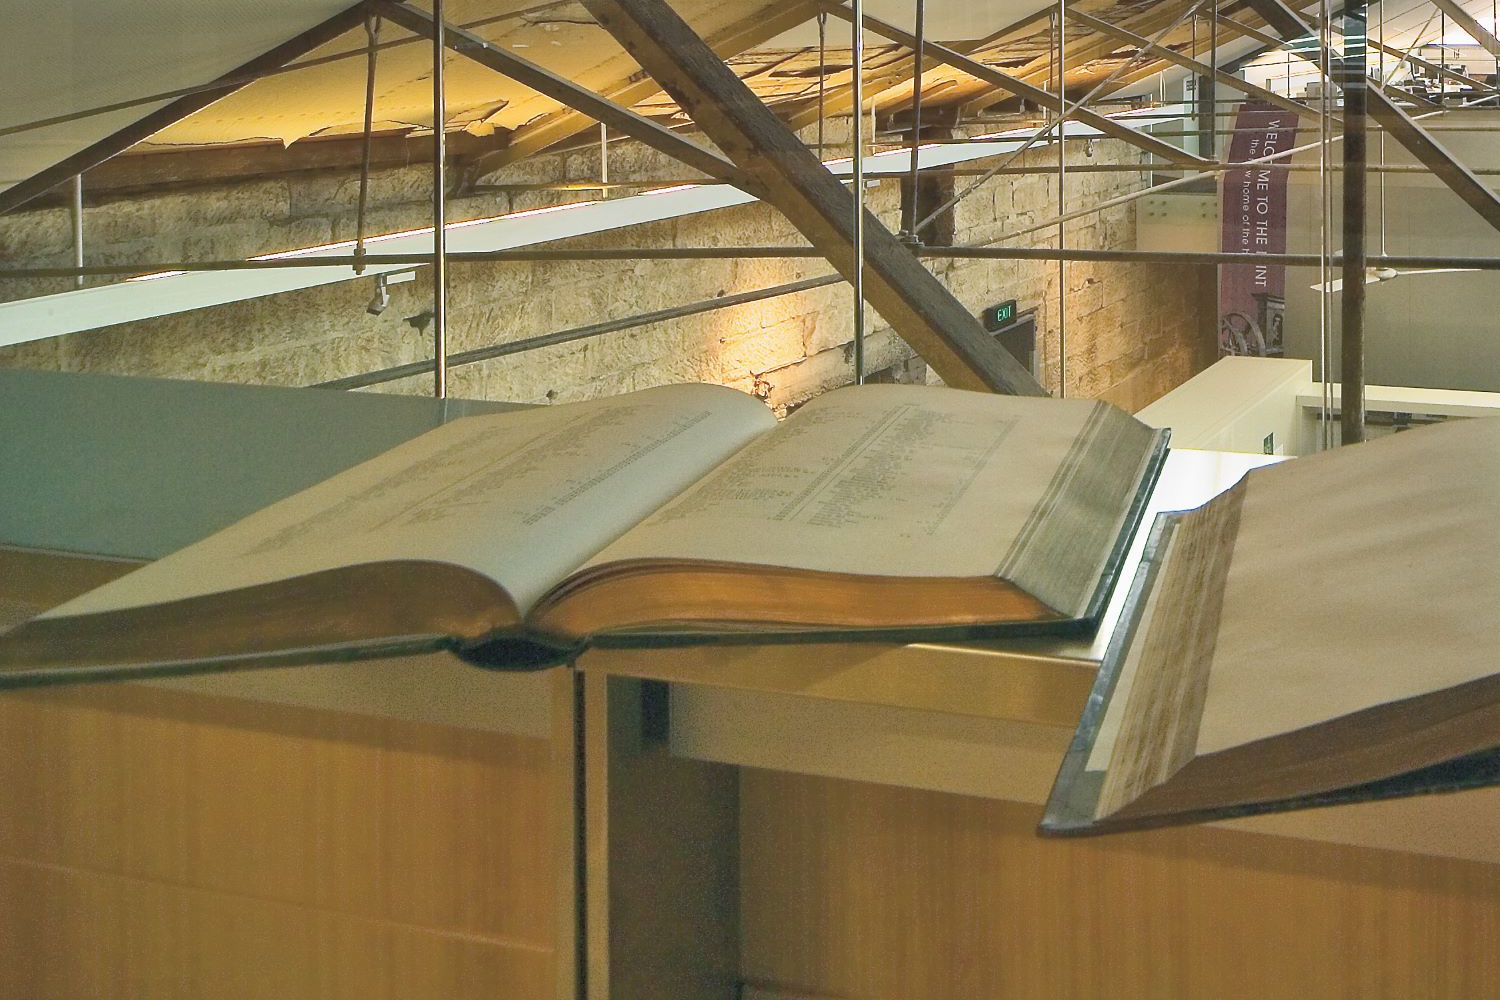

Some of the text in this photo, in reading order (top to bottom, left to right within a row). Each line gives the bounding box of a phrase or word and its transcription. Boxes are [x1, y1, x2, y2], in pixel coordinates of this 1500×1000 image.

[1249, 139, 1260, 155] the
[1242, 181, 1252, 211] home
[1255, 119, 1281, 287] WELCME TO THE INT
[1242, 214, 1250, 226] of
[1241, 228, 1251, 245] the
[997, 304, 1012, 322] EXIT
